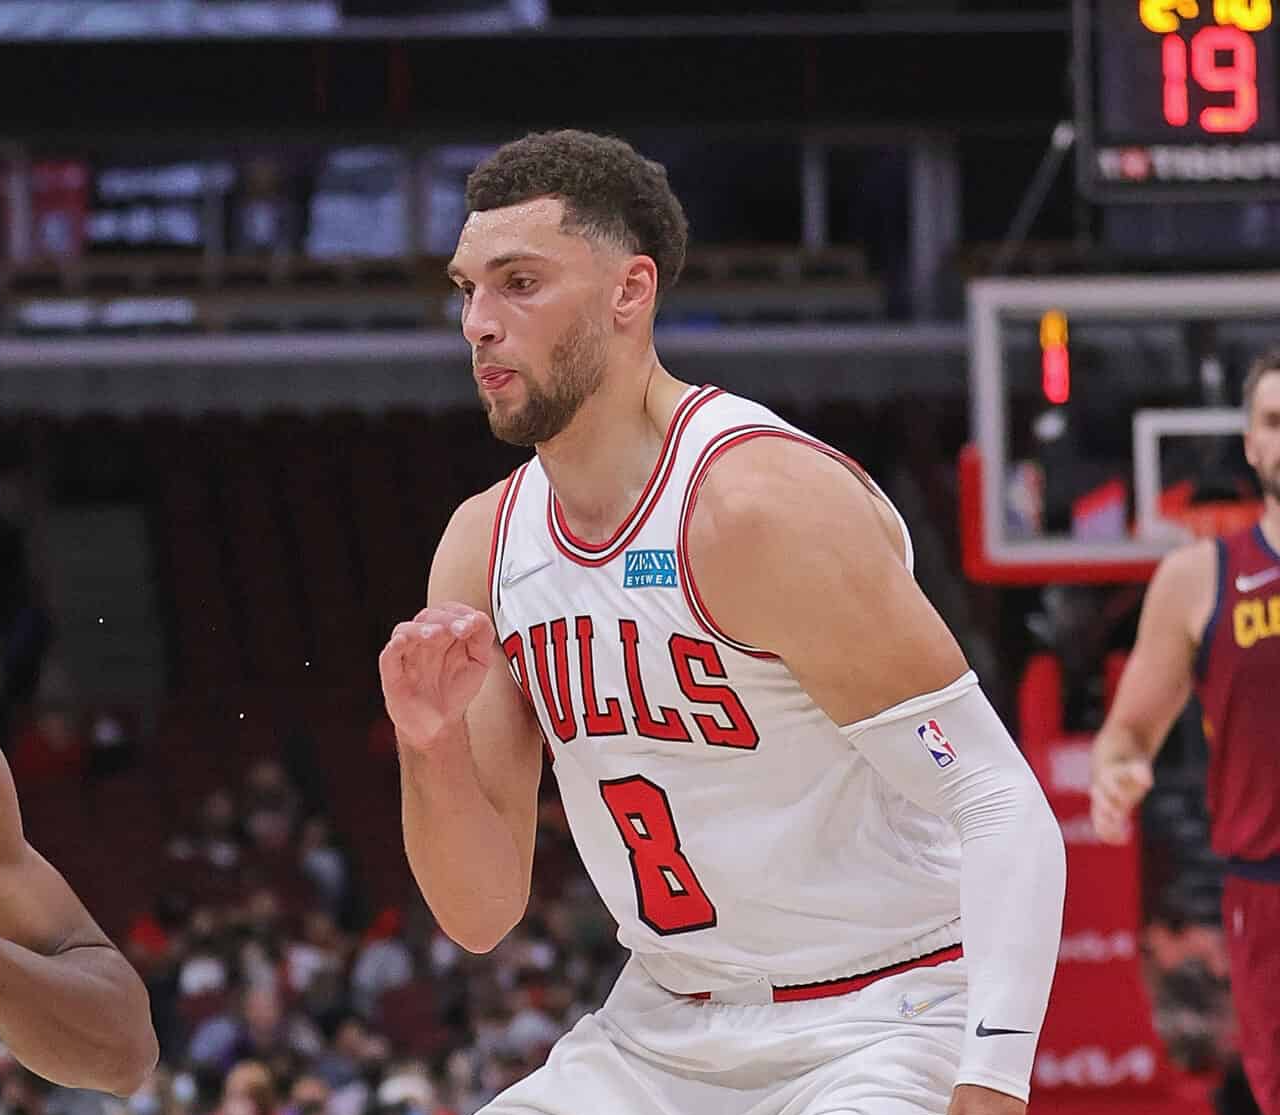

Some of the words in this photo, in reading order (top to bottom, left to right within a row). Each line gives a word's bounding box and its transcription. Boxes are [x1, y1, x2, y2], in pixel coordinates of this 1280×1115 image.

[1161, 25, 1259, 134] 19
[626, 575, 677, 586] EYEWEA
[598, 774, 718, 937] 8
